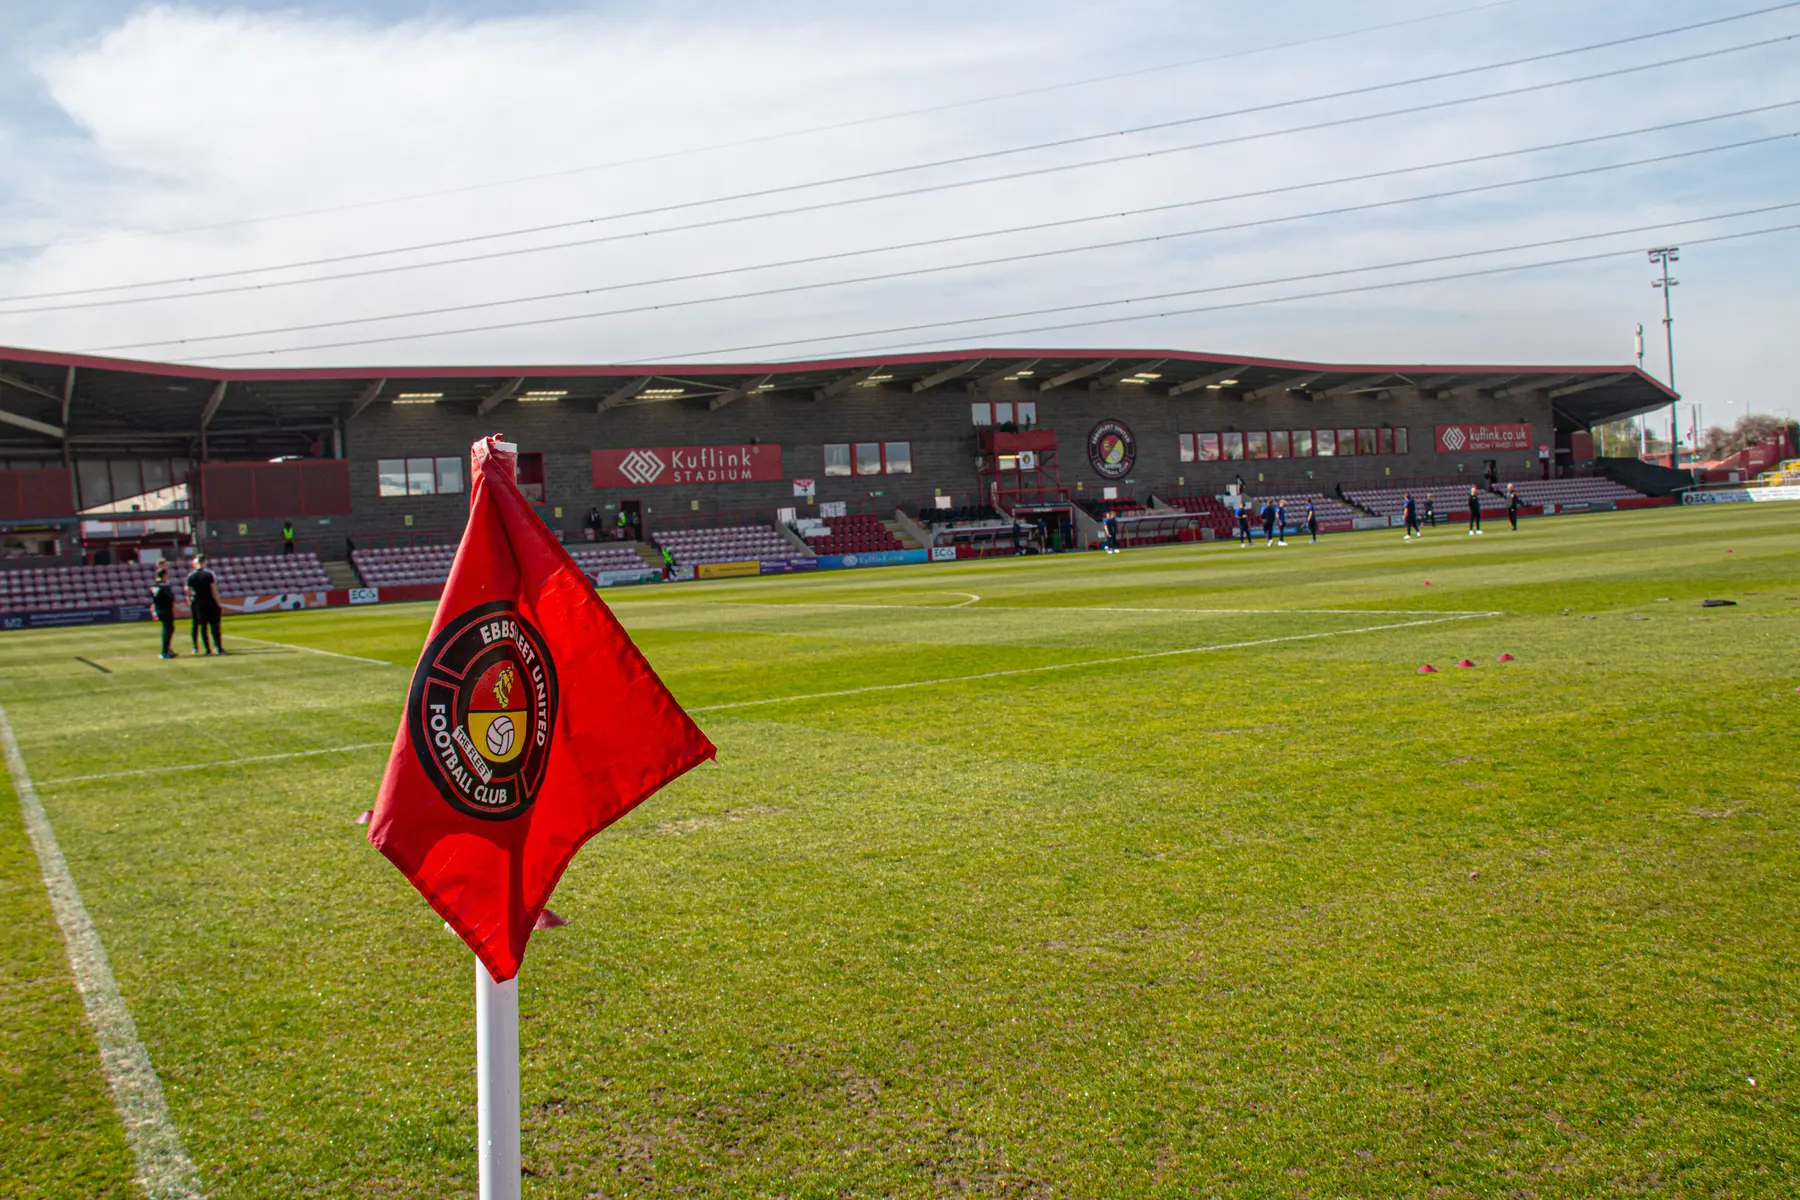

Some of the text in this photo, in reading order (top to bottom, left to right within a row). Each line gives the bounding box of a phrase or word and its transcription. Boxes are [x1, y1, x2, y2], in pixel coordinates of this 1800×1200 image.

[1469, 426, 1526, 441] kuflink.co.uk
[671, 447, 752, 469] Kuflink
[674, 469, 752, 482] STADIUM
[480, 620, 548, 747] EBBSLEET UNITED
[430, 704, 507, 804] FOOTBALL CLUB
[456, 730, 489, 777] THE FLEET
